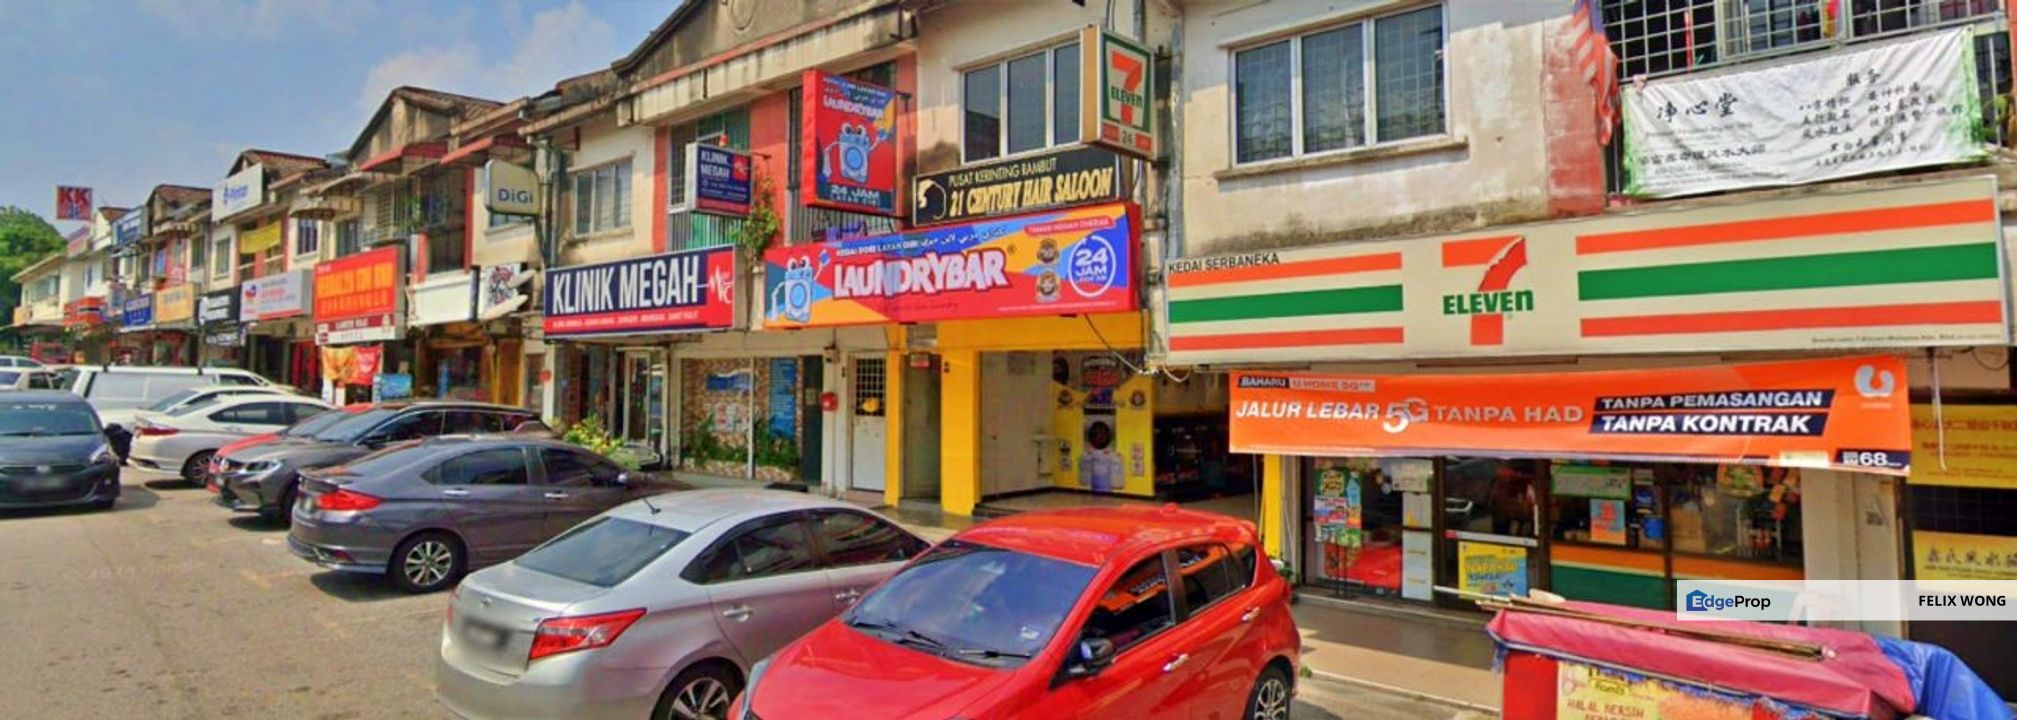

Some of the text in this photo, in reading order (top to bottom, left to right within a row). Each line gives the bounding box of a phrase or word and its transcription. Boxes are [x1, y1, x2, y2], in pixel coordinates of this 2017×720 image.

[1111, 49, 1143, 125] 7
[824, 95, 883, 119] LAUNDRYBAR
[701, 150, 729, 164] KLINIK
[701, 164, 730, 178] MEGAH
[949, 157, 1057, 186] PUSAT KERINTING RAMBUT
[832, 184, 880, 200] 24 JAM
[950, 167, 1114, 217] 21 CENTURY HAIR SALOON
[1076, 248, 1108, 266] 24
[1168, 252, 1280, 273] KEDAI SERBANEKA
[834, 250, 1009, 298] LAUNDRYBAR
[1075, 264, 1107, 277] JAM
[552, 255, 699, 315] KLINIK MEGAH
[1442, 234, 1528, 346] 7
[1241, 376, 1286, 387] BAHARU
[1603, 391, 1822, 410] TANPA PEMASANGAN
[1236, 397, 1583, 434] JALUR LEBAR 5G TANPA HAD
[1602, 413, 1811, 433] TANPA KONTRAK
[1860, 451, 1888, 466] 68
